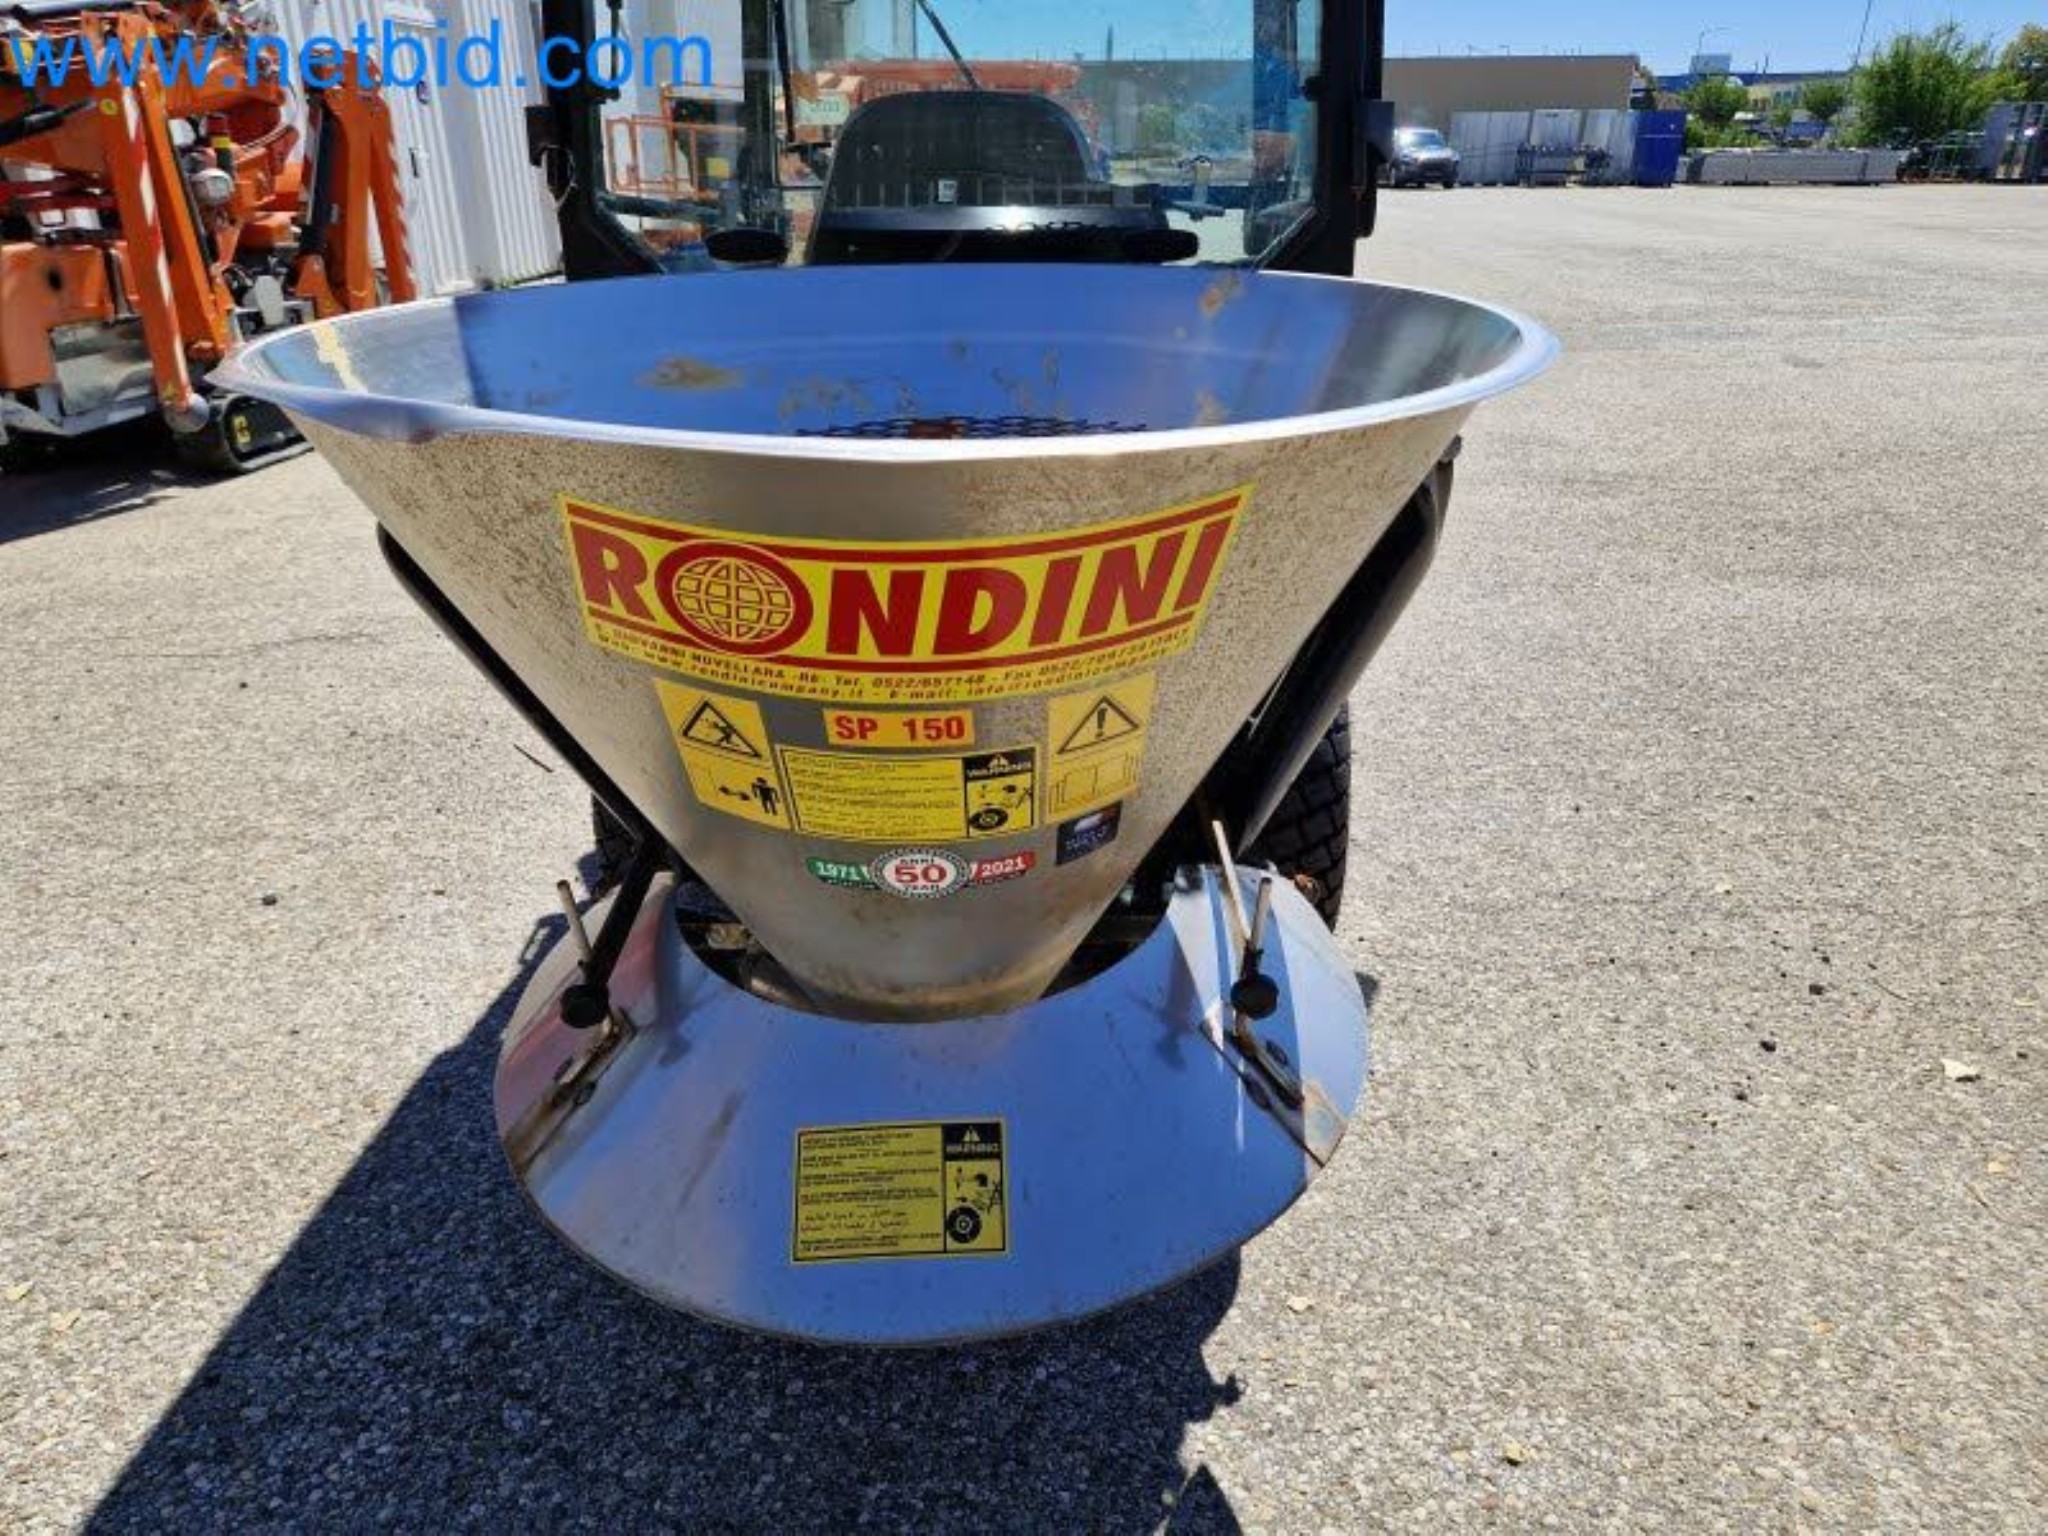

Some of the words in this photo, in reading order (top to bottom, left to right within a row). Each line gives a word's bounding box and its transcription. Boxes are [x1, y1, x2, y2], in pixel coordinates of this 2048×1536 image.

[568, 516, 1233, 658] RONDINI
[834, 714, 878, 740] SP
[902, 715, 965, 742] 150
[815, 860, 861, 881] 1971
[893, 864, 948, 884] 50
[981, 856, 1027, 877] 2021
